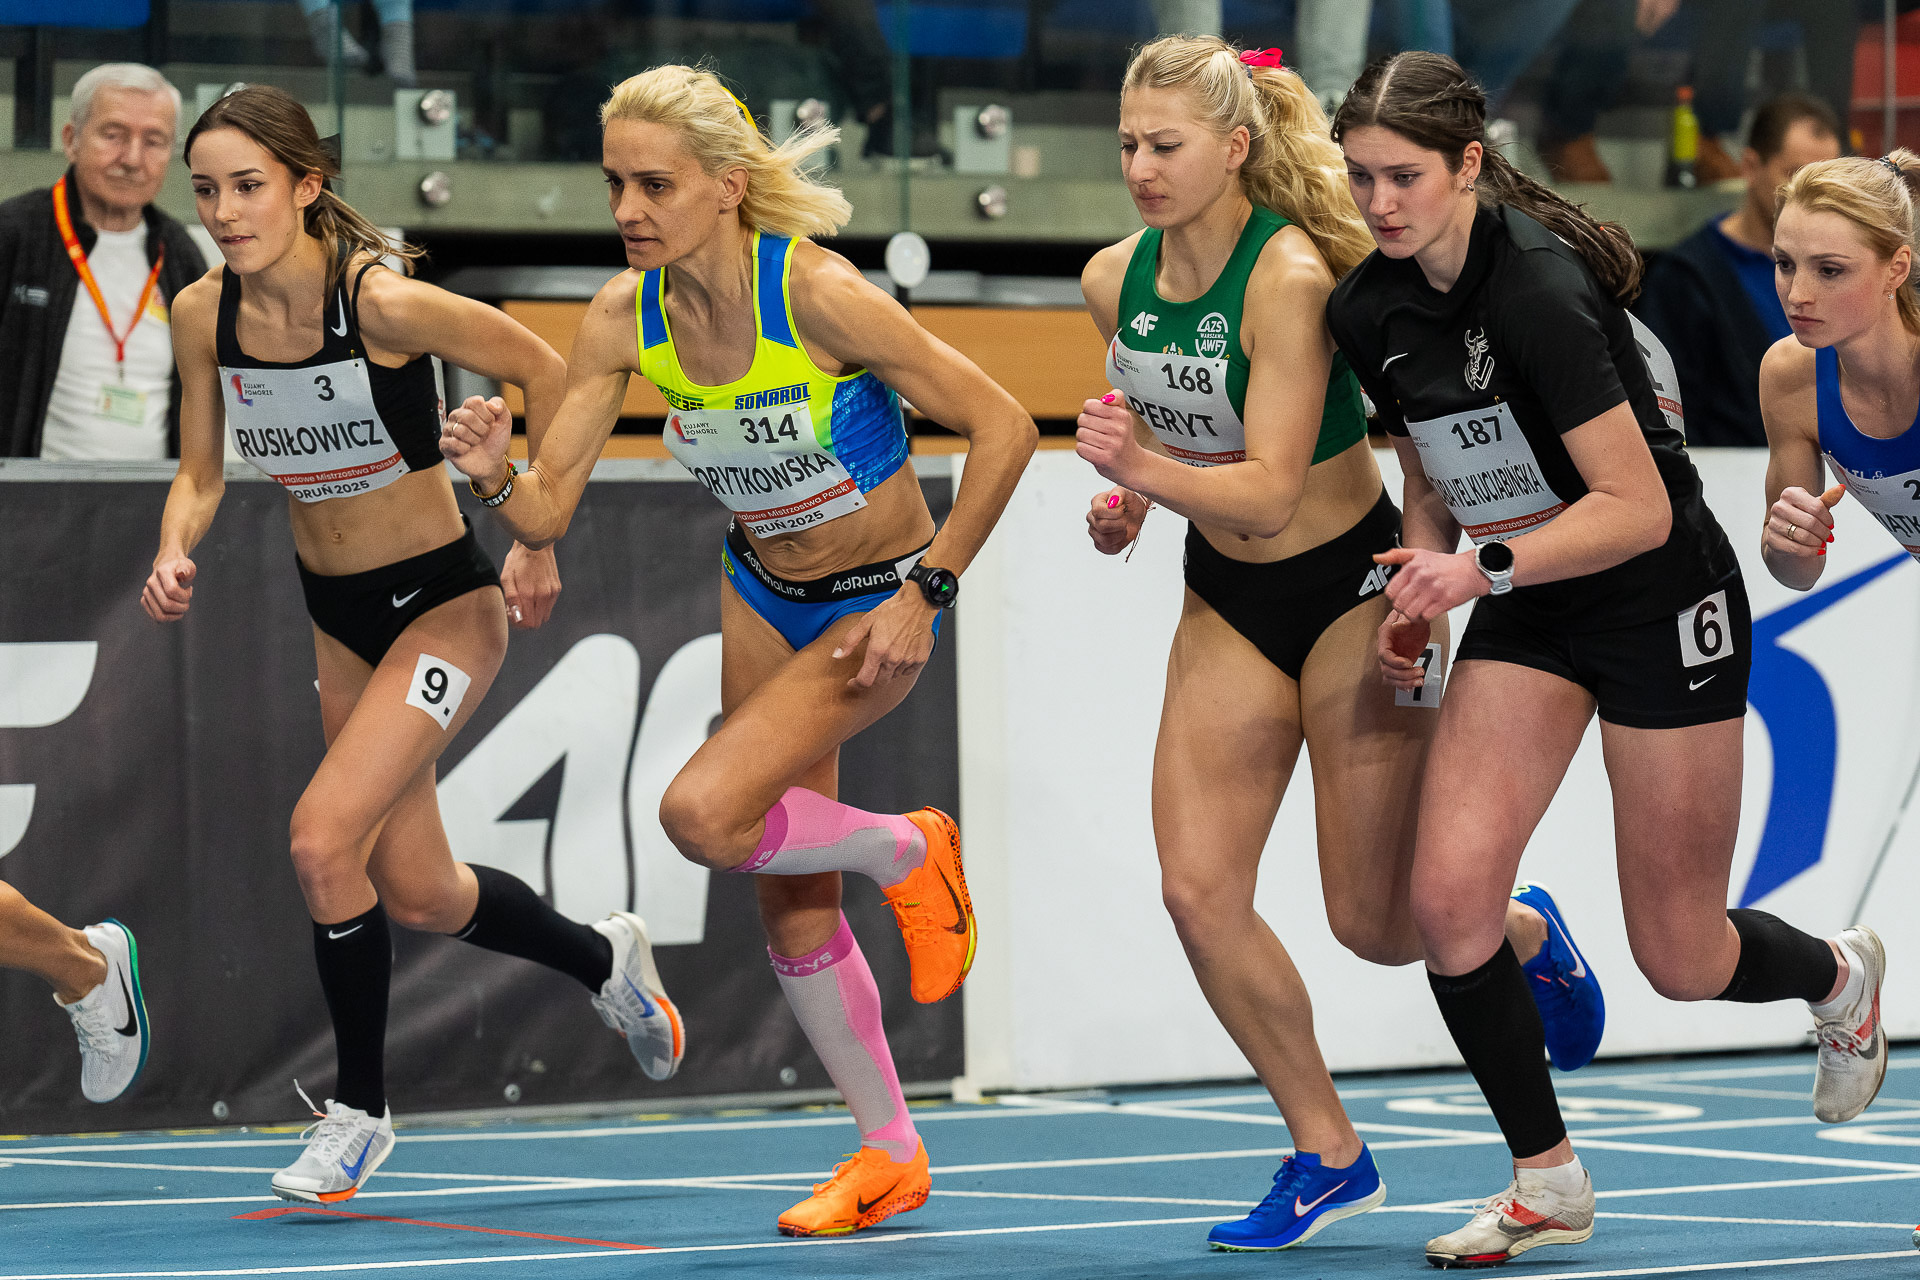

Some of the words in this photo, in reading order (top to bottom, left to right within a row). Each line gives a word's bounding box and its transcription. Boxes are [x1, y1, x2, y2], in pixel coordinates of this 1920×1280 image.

[1130, 311, 1159, 338] 4F
[1199, 320, 1223, 333] AZS
[1200, 340, 1224, 352] AWF
[313, 375, 335, 402] 3
[1161, 362, 1214, 395] 168
[734, 382, 811, 411] SONAROL
[235, 419, 385, 458] RUSIŁOWICZ
[686, 428, 718, 436] POMORZE
[739, 413, 799, 444] 314
[1450, 415, 1503, 450] 187
[283, 473, 315, 485] Halowe
[316, 465, 369, 482] Mistrzostwa
[369, 457, 397, 472] Polski
[688, 453, 836, 495] ORYTKOWSKA
[291, 484, 334, 500] ORUŃ
[334, 480, 370, 495] 2025
[767, 496, 822, 518] Mistrzostwa
[821, 484, 850, 500] Polski
[786, 511, 825, 528] 2025
[1488, 516, 1537, 532] Mistrzostwa
[1536, 505, 1564, 521] Polski
[1692, 600, 1723, 657] 6
